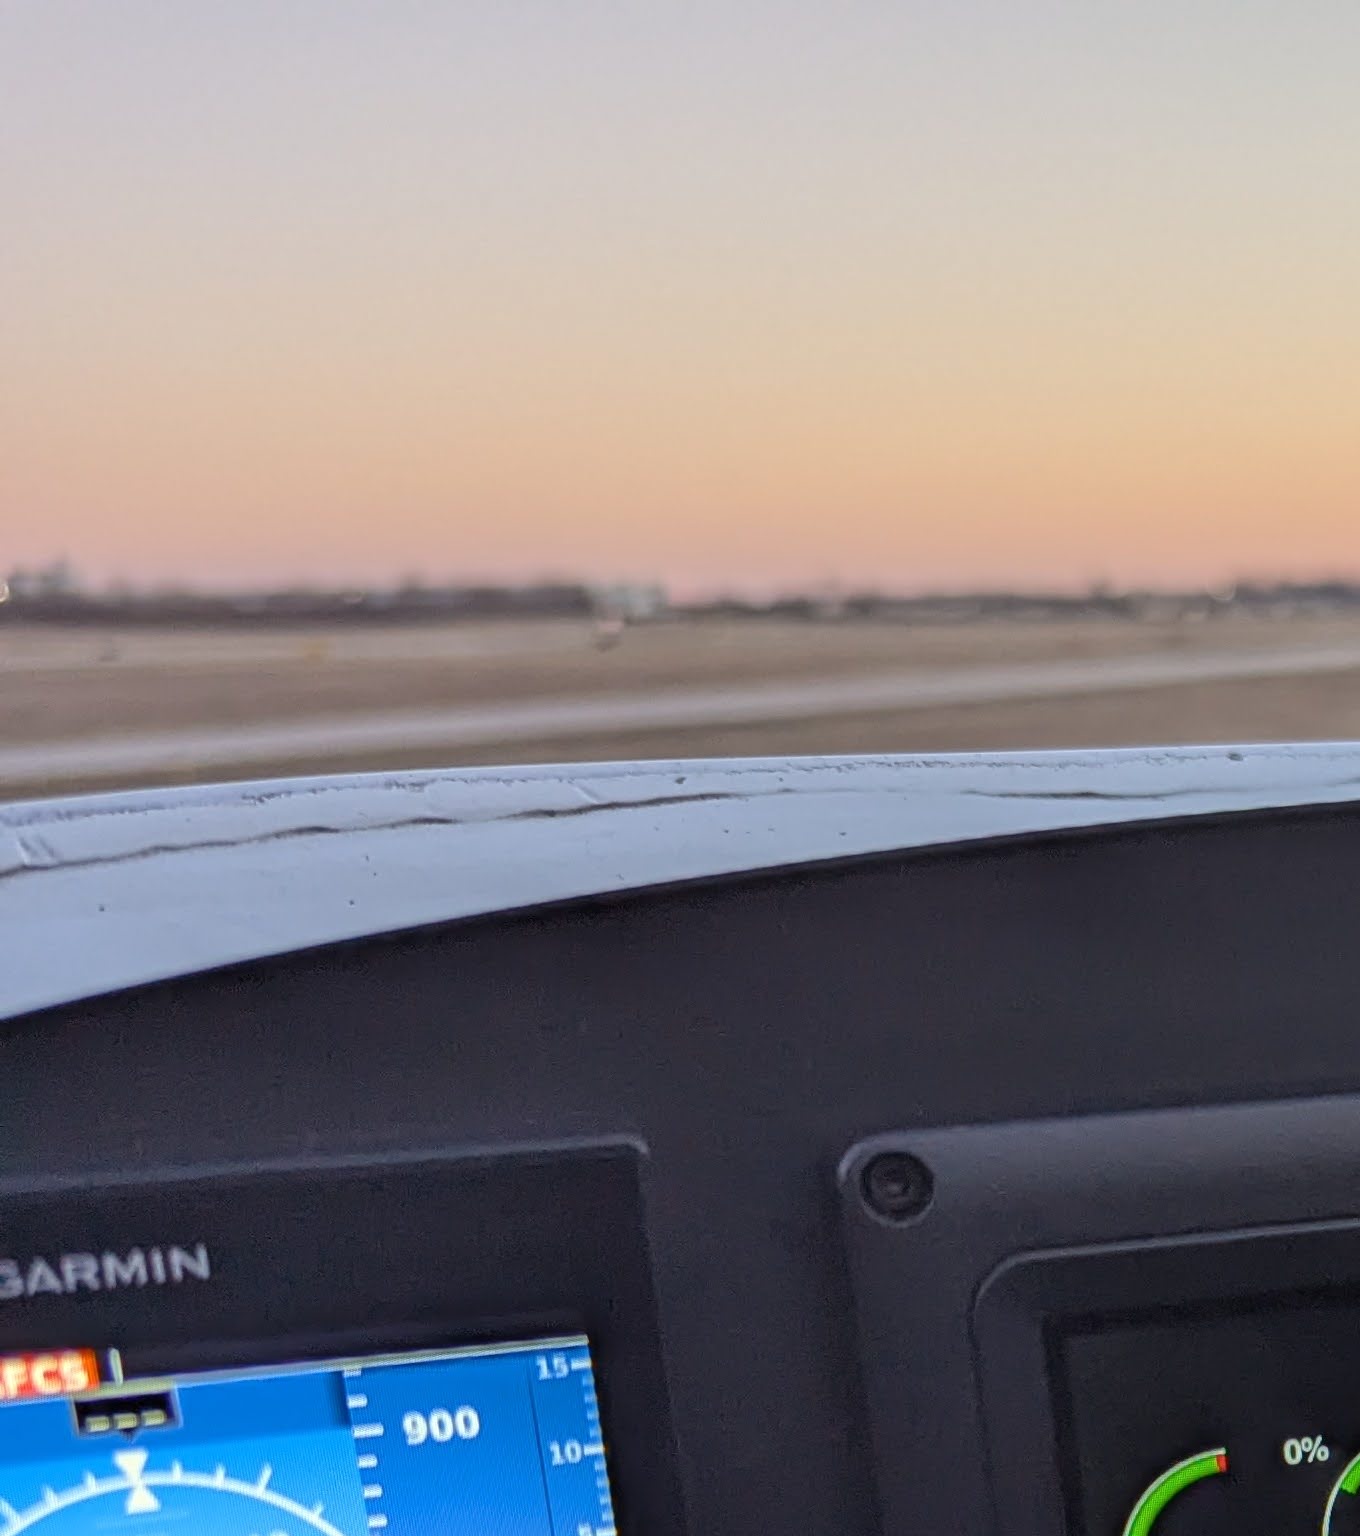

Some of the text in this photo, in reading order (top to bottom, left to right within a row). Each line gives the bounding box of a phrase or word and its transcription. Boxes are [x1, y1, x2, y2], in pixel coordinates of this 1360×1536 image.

[0, 1351, 90, 1400] FCS
[536, 1356, 571, 1381] 15
[402, 1405, 481, 1446] 900
[550, 1440, 582, 1467] 10
[1283, 1435, 1330, 1467] 0%
